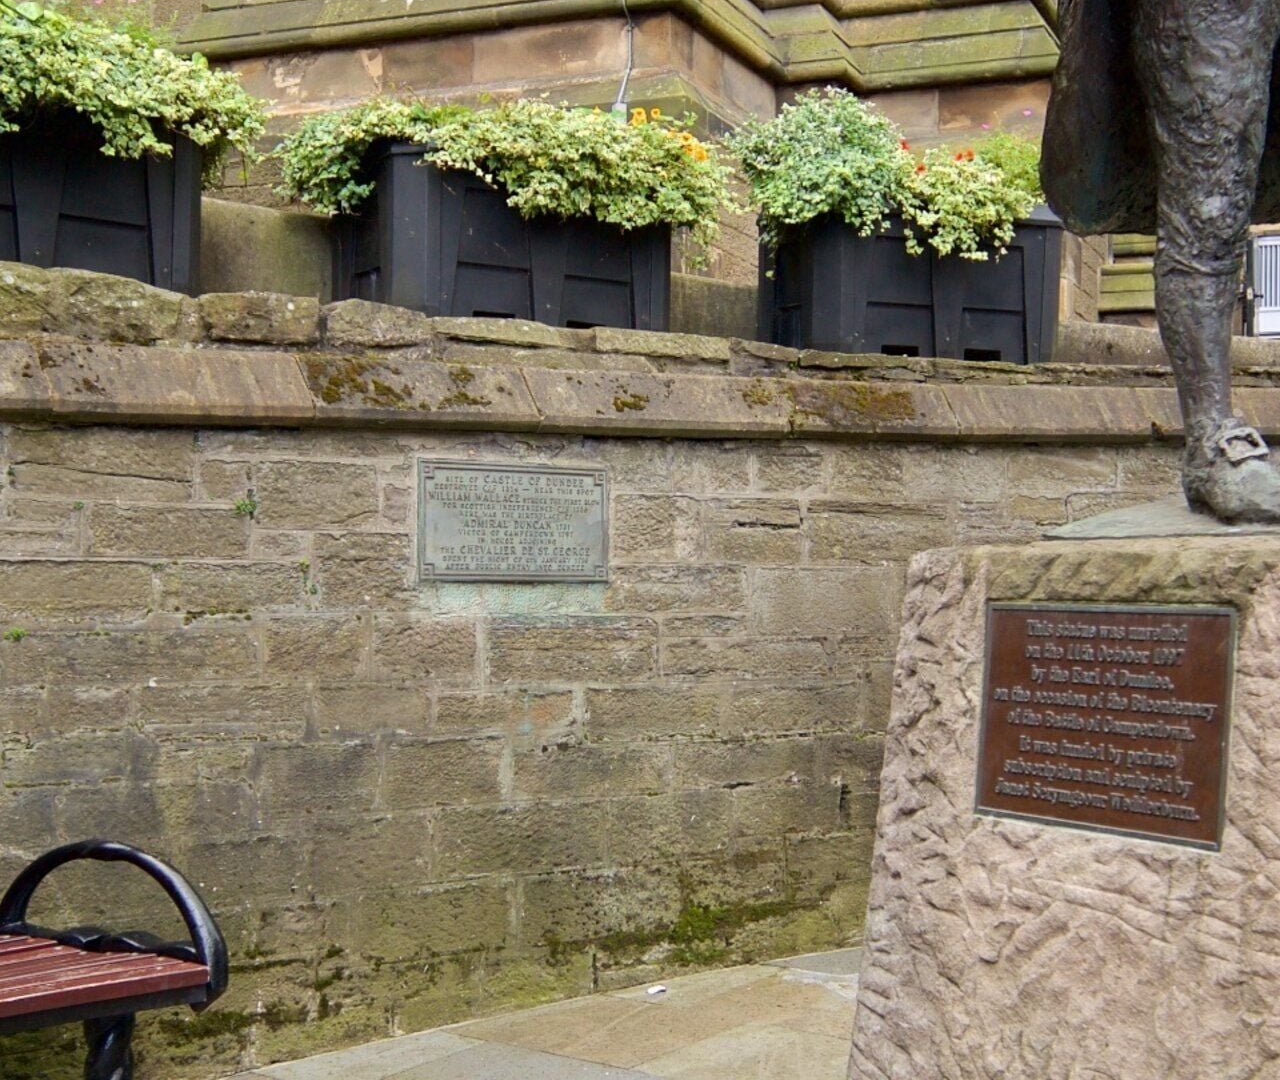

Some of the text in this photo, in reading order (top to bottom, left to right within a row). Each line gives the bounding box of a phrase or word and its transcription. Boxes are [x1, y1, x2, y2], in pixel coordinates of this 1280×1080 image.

[483, 475, 523, 486] CASTLE
[528, 476, 541, 486] OF
[546, 477, 584, 488] DUNDEE
[428, 491, 470, 502] WILLIAM
[475, 492, 520, 503] WALLACE
[463, 519, 509, 529] ADMIRAL
[514, 520, 552, 530] DUNCAN
[459, 545, 518, 556] CHEVALIER
[522, 546, 535, 556] DE
[553, 547, 591, 557] GEORGE
[1026, 619, 1188, 641] This statue was unveiled
[1025, 645, 1041, 658] on
[1043, 642, 1064, 659] the
[1097, 645, 1150, 664] October
[1031, 664, 1047, 684] by
[1049, 666, 1070, 682] the
[1071, 666, 1101, 684] Earl
[1103, 669, 1118, 686] of
[993, 688, 1009, 701] on
[1011, 685, 1031, 702] the
[1033, 689, 1087, 707] occasion
[1089, 692, 1105, 709] of
[1106, 692, 1128, 710] the
[1007, 708, 1021, 724] of
[1022, 708, 1042, 726] the
[1044, 710, 1084, 730] Battle
[1086, 715, 1102, 732] of
[1032, 740, 1058, 754] was
[1059, 739, 1105, 761] funded
[1107, 744, 1125, 766] by
[1126, 748, 1177, 770] private
[994, 777, 1029, 796] Janet
[1003, 757, 1195, 799] subscription and sculpted by
